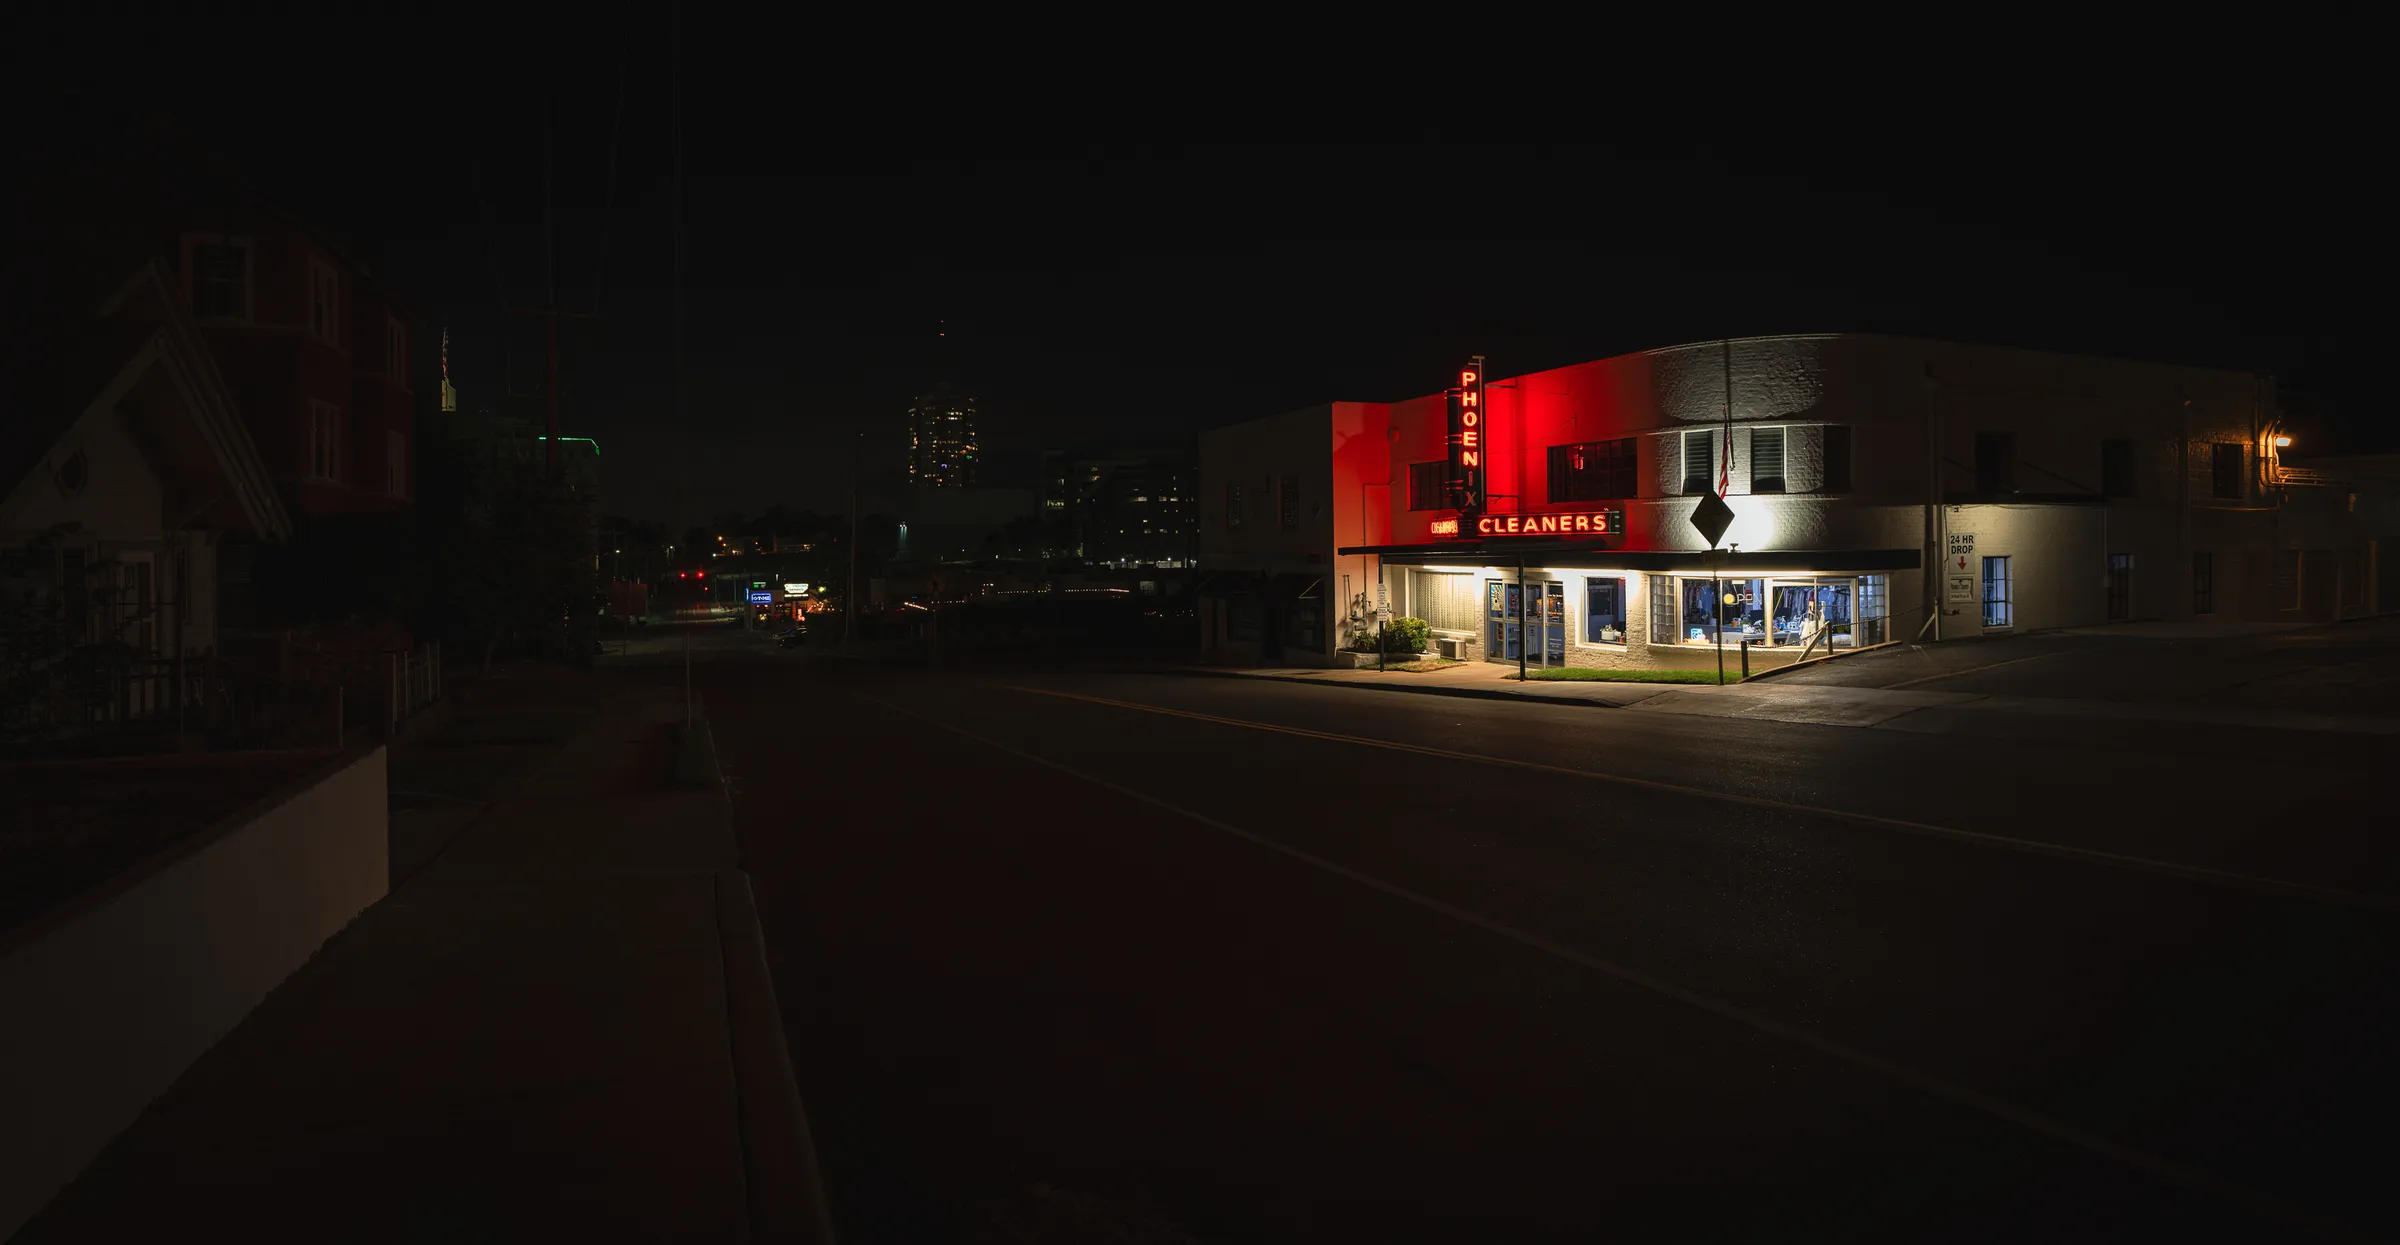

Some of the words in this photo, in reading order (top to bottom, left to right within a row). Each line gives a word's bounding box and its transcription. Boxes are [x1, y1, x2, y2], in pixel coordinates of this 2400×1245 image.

[1462, 371, 1478, 507] PHOENIX
[1479, 515, 1607, 533] CLEANERS
[1950, 535, 1960, 544] 24
[1962, 535, 1974, 544] HR
[1951, 545, 1974, 554] DROP
